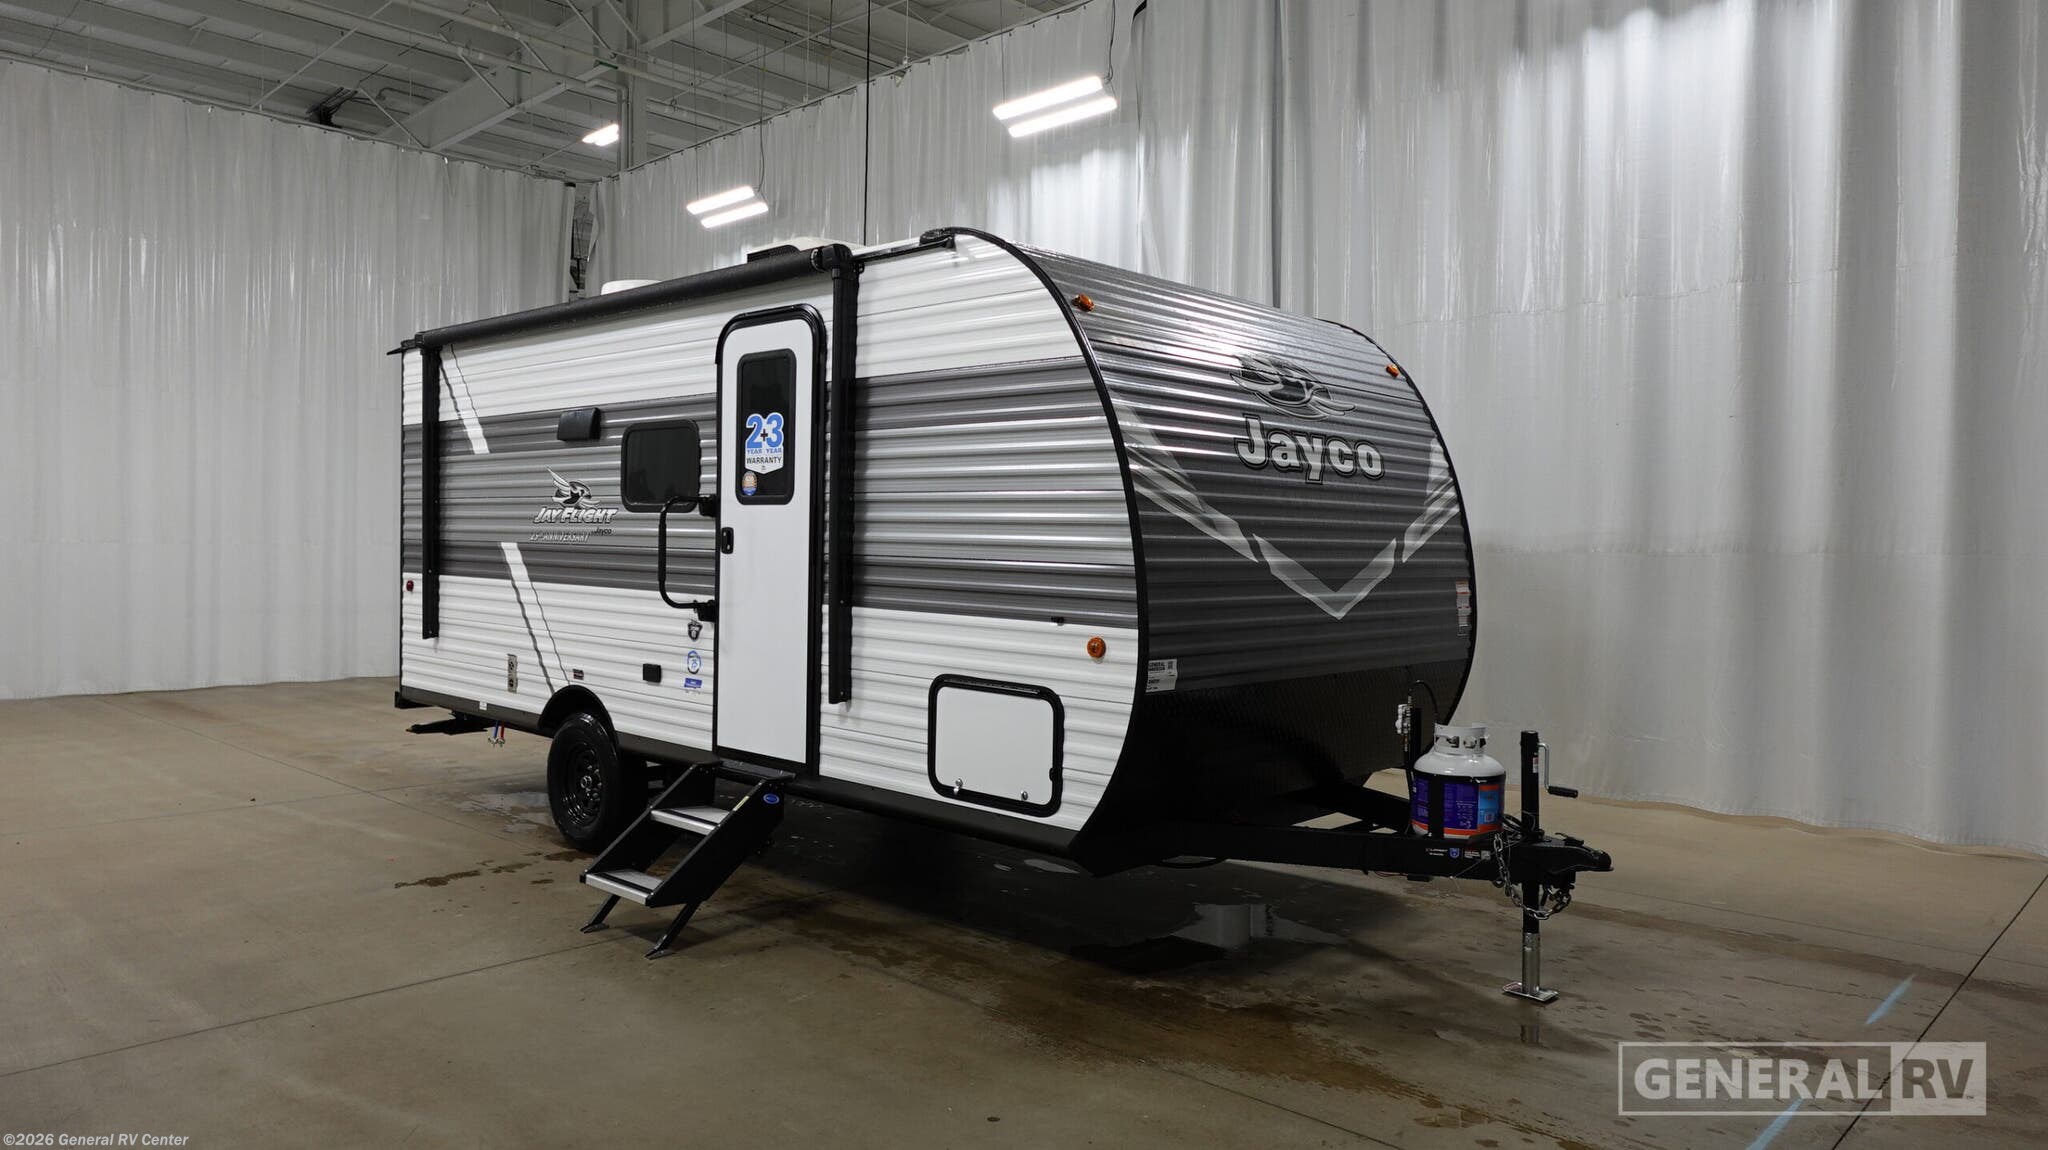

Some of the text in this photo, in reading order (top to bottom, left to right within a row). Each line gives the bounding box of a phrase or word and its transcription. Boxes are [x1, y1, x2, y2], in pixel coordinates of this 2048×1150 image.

[1234, 413, 1385, 485] Jayco
[746, 456, 782, 464] WARRANTY
[533, 507, 619, 524] JAY FLIGHT
